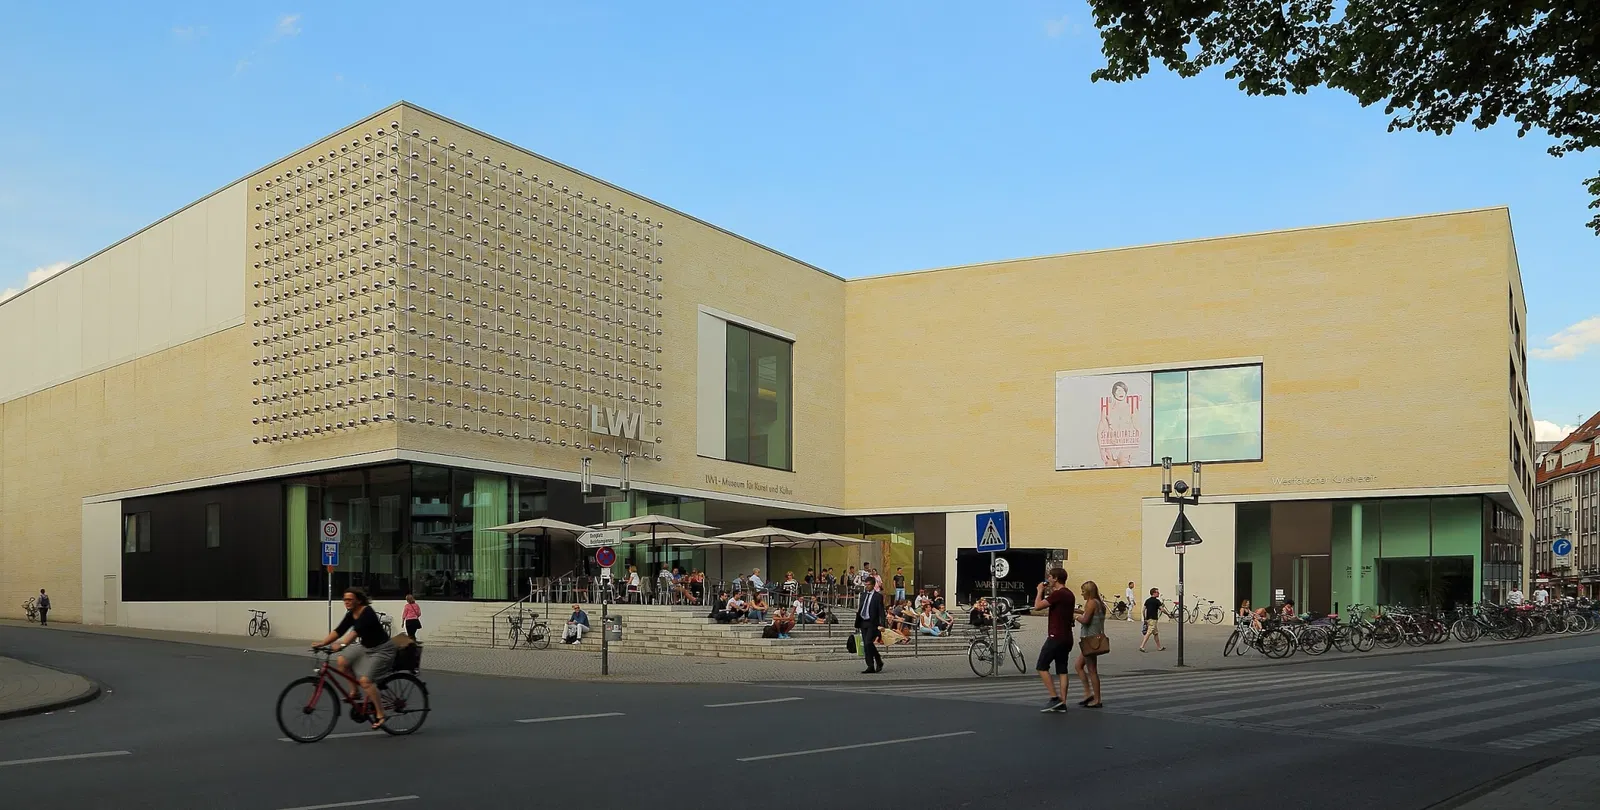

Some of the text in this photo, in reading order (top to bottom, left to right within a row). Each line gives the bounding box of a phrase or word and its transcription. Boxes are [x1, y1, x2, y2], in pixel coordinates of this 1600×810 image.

[588, 404, 655, 443] LWL
[754, 482, 768, 492] Kunst
[769, 485, 778, 494] und
